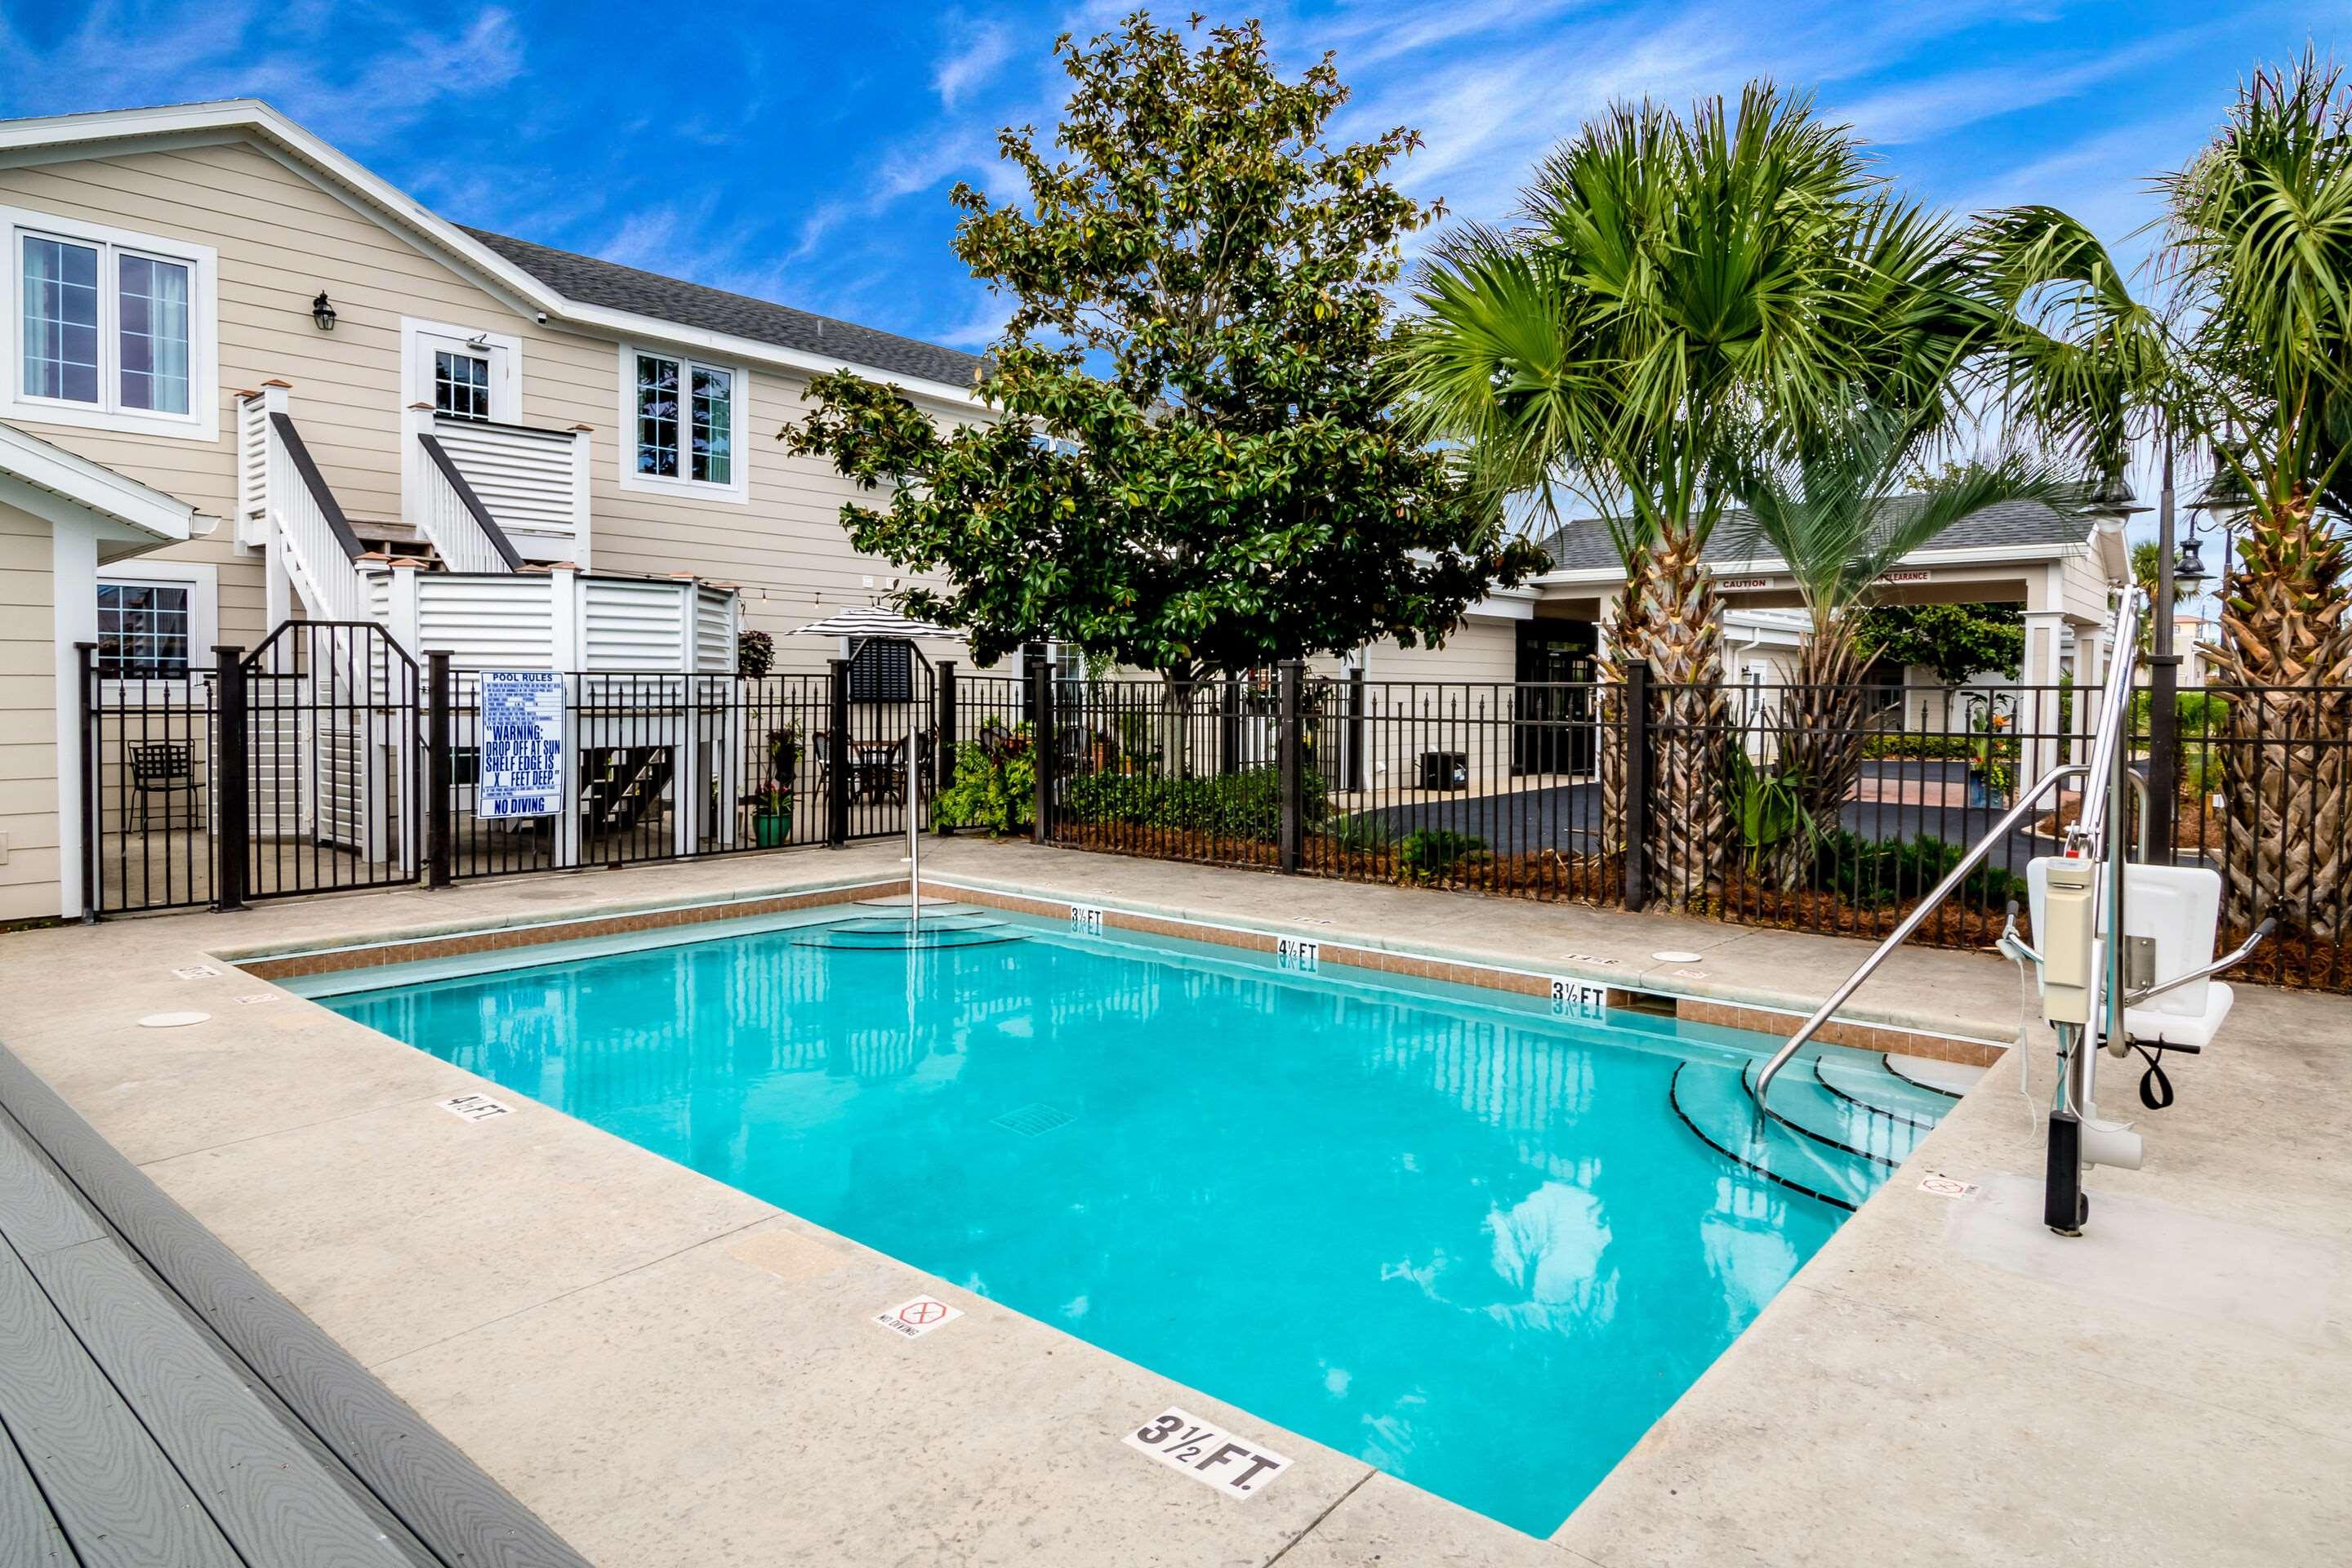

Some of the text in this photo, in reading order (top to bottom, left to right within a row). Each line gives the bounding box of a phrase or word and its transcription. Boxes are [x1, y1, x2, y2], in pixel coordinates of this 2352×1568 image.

[1722, 578, 1766, 588] CAUTION
[492, 673, 553, 681] POOL RULES
[486, 740, 560, 757] DROP OFF AT SUN
[486, 755, 555, 772] SHELF EDGE IS
[510, 771, 530, 786] FEET
[494, 797, 545, 815] NO DIVING
[1194, 1442, 1281, 1491] FT.
